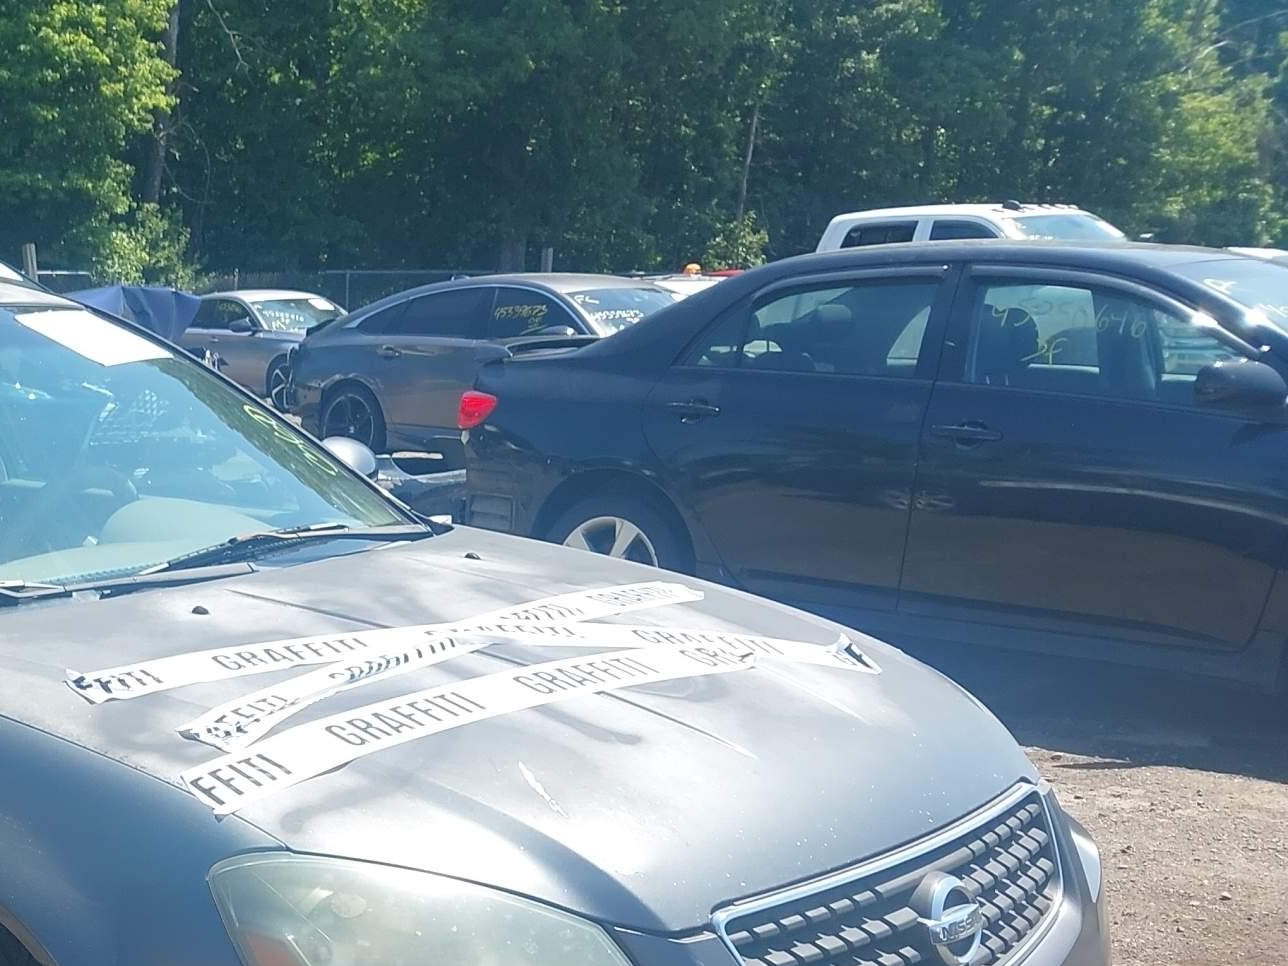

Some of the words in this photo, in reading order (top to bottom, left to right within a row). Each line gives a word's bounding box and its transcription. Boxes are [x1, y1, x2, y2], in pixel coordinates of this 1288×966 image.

[211, 637, 369, 671] GRAFFITI
[189, 752, 292, 806] FFITI
[324, 691, 487, 746] GRAFFITI
[512, 656, 661, 695] GRAFFITI
